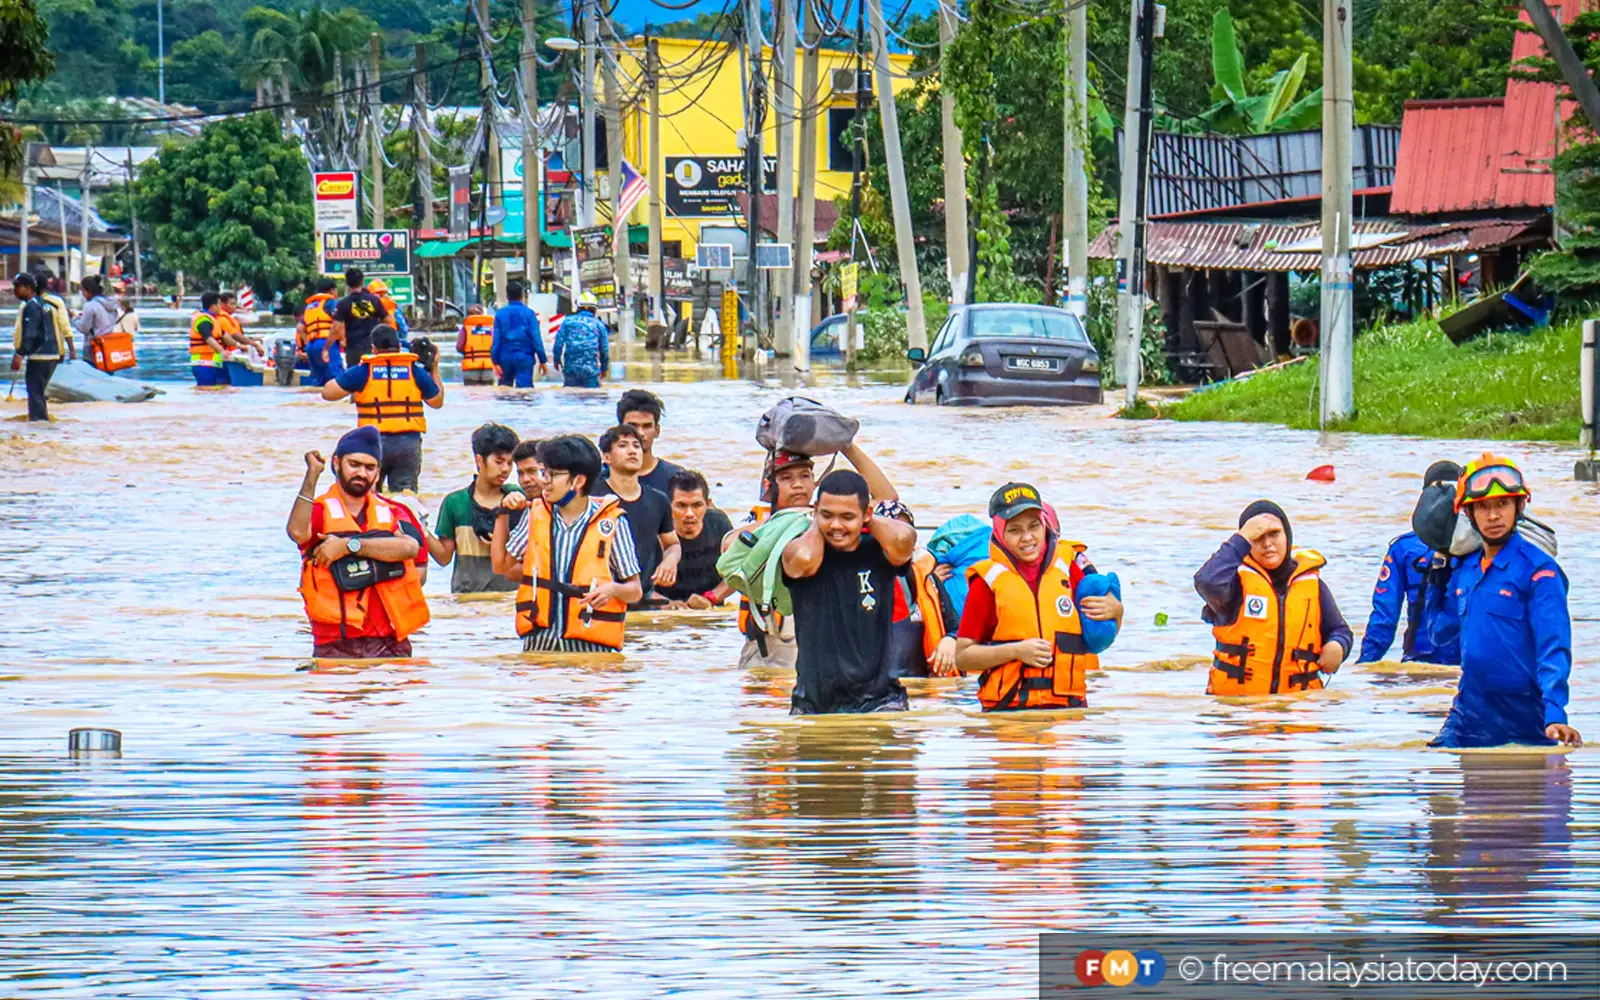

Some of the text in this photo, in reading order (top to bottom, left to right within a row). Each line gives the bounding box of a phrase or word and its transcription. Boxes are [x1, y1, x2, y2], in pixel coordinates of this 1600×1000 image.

[706, 160, 777, 173] SAHAAT
[326, 233, 406, 249] MY BEKM
[857, 569, 875, 594] K
